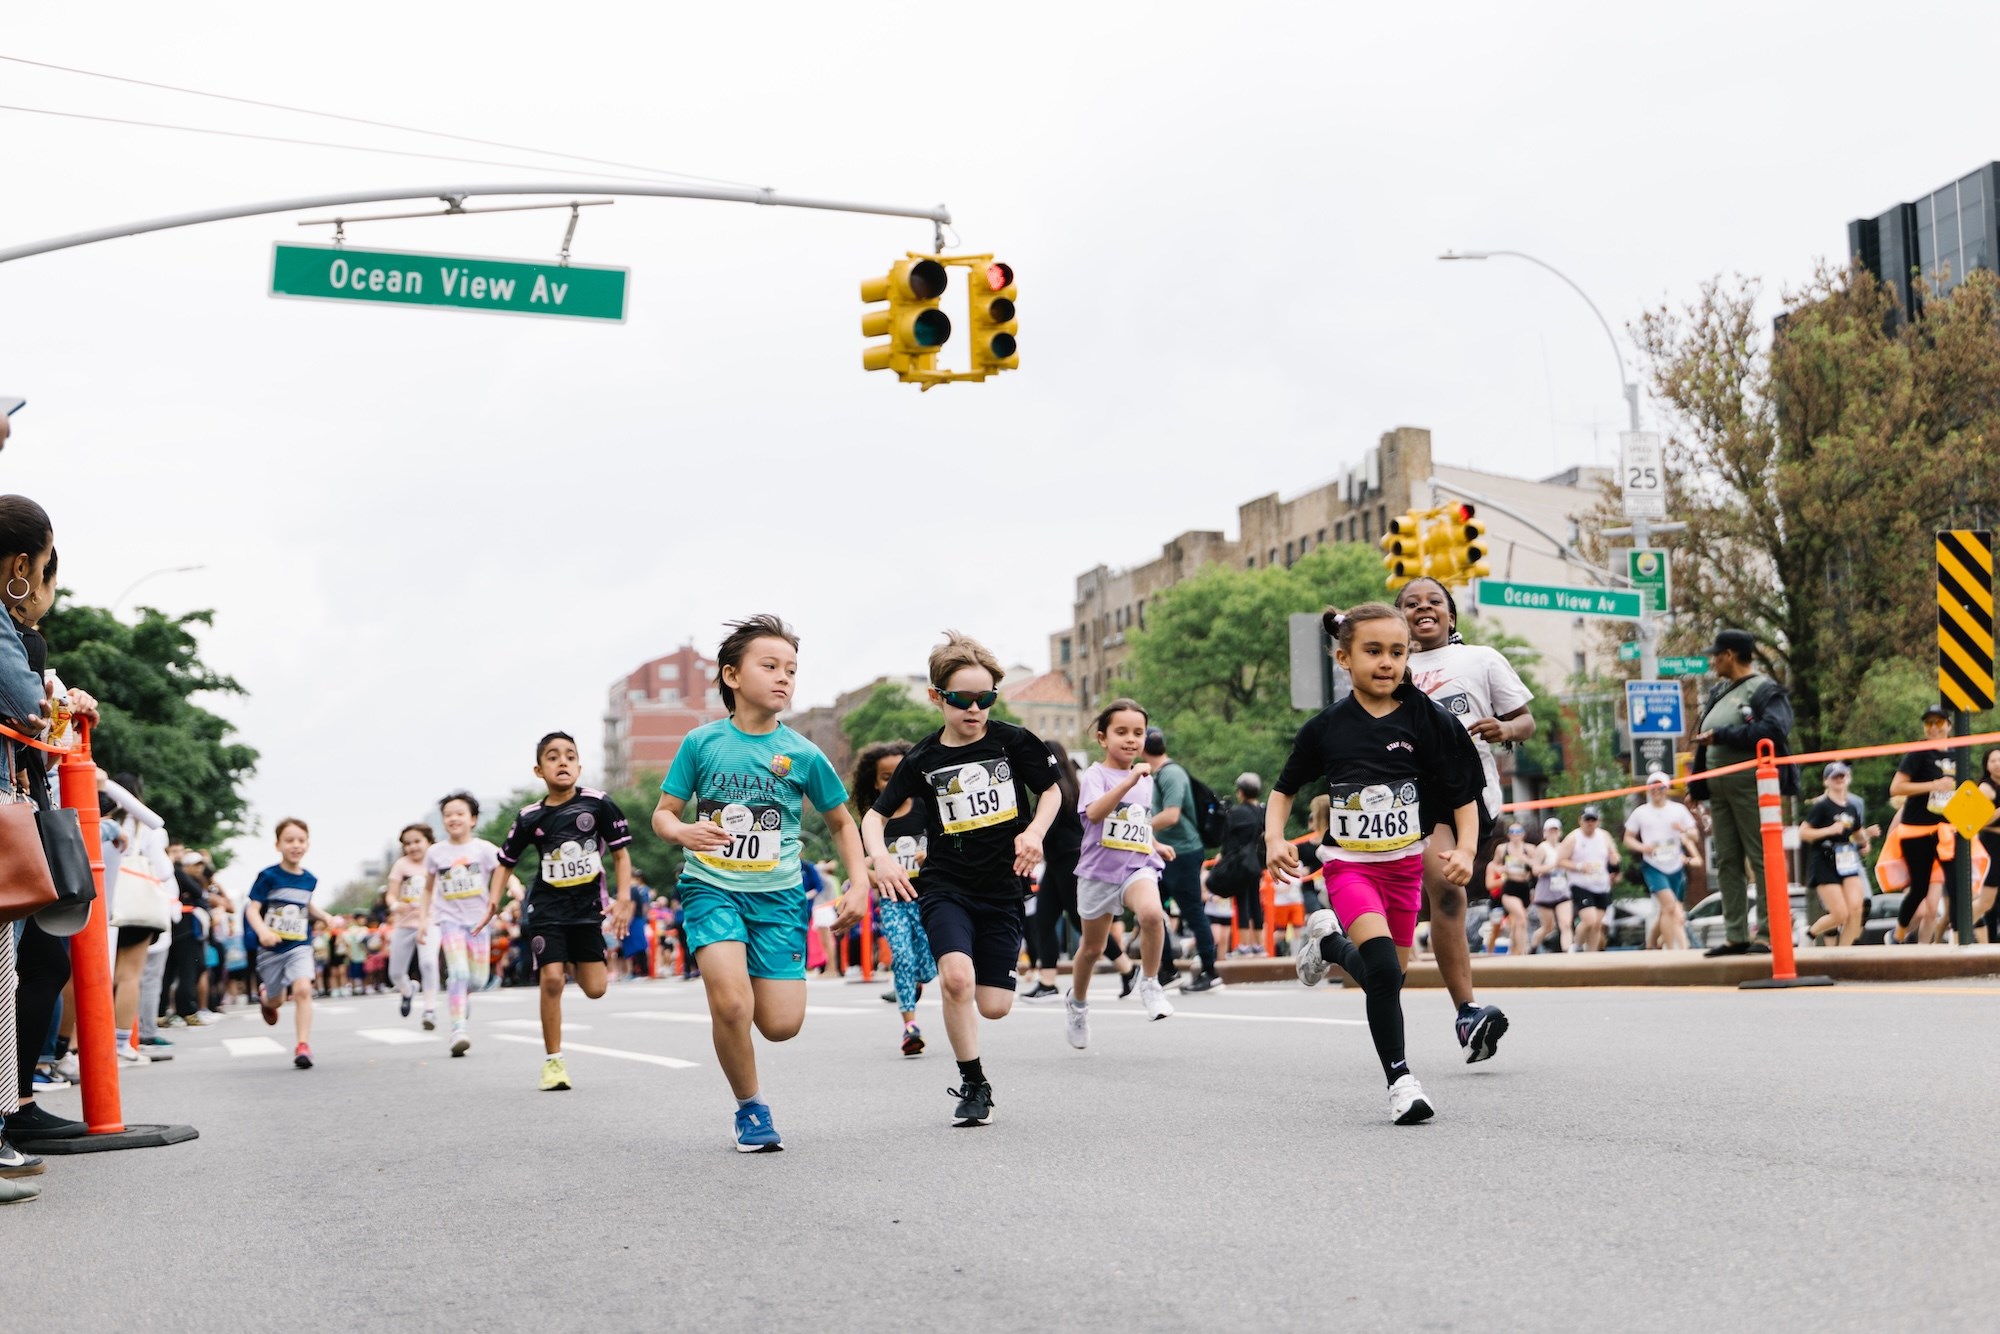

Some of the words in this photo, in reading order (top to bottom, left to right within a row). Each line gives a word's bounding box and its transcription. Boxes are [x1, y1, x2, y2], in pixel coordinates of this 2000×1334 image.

[329, 258, 423, 295] Ocean
[440, 266, 517, 302] View
[530, 274, 569, 305] Av
[1629, 467, 1658, 489] 25
[1503, 586, 1550, 607] Ocean
[1556, 592, 1592, 611] View
[1597, 596, 1617, 613] Av
[712, 770, 777, 792] QATAR
[966, 788, 1000, 817] 159
[1338, 815, 1349, 836] I
[1358, 810, 1408, 839] 2468
[561, 858, 592, 878] 1955
